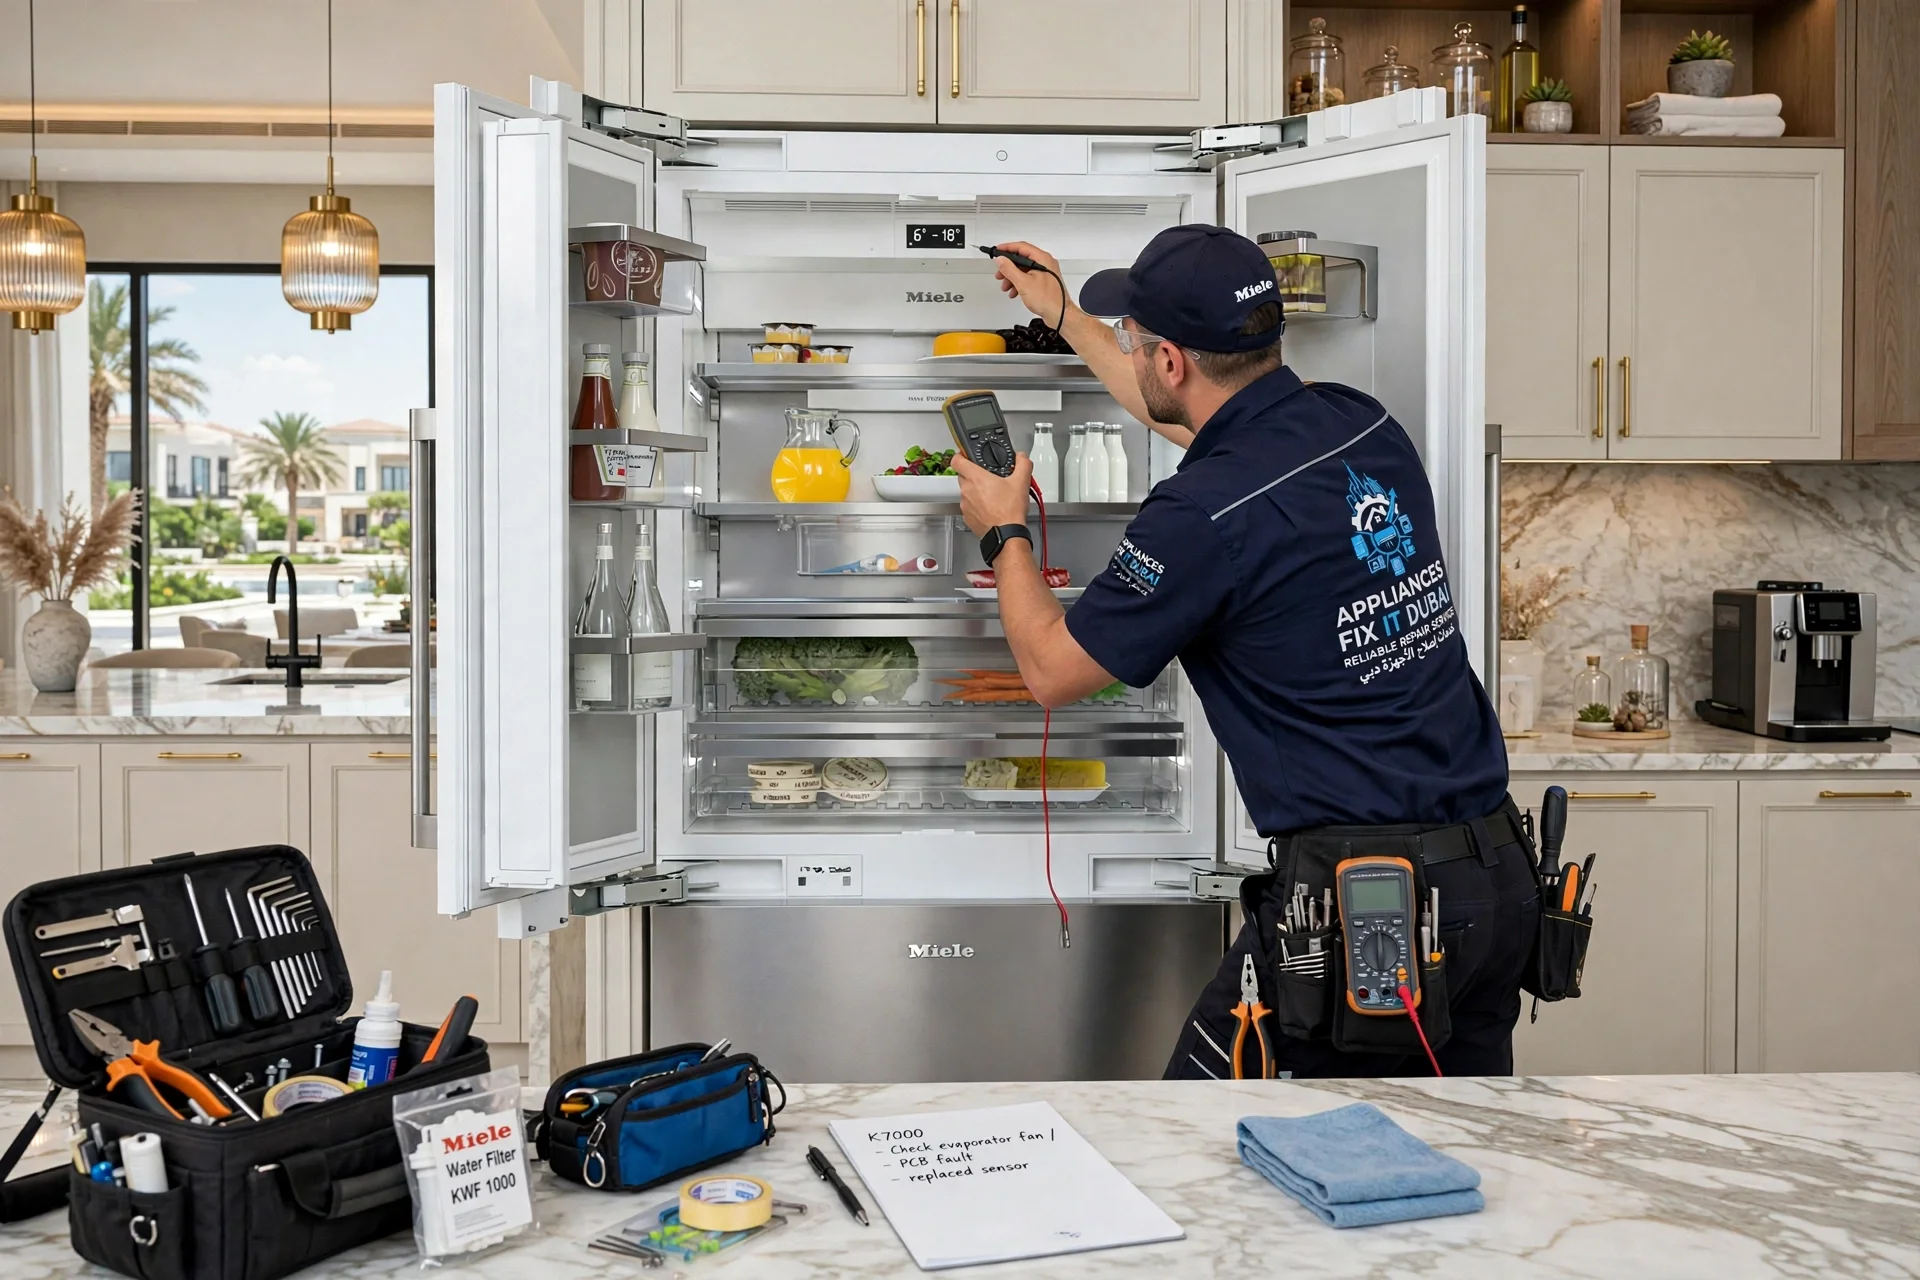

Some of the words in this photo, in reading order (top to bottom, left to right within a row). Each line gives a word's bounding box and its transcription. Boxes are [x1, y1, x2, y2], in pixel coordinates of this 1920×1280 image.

[906, 292, 964, 303] Miele
[1234, 280, 1273, 303] Miele
[1337, 560, 1444, 628] APPLIANCES
[1338, 621, 1380, 653] FIX
[1382, 610, 1401, 637] IT
[1405, 582, 1450, 627] DUBAI
[1343, 640, 1399, 668] RELIABLE
[1399, 624, 1431, 648] REPAIR
[908, 944, 975, 959] Miele
[442, 1125, 511, 1154] Miele
[868, 1128, 924, 1142] K7000
[891, 1142, 933, 1155] Check
[939, 1134, 1012, 1151] evaporator
[1019, 1130, 1044, 1142] fan
[446, 1158, 483, 1178] Water
[486, 1149, 516, 1168] Filter
[899, 1157, 929, 1169] PCB
[936, 1152, 974, 1165] fault
[909, 1165, 974, 1184] replaced
[981, 1162, 1029, 1174] sensor
[451, 1181, 482, 1205] KWF
[486, 1172, 516, 1194] 1000
